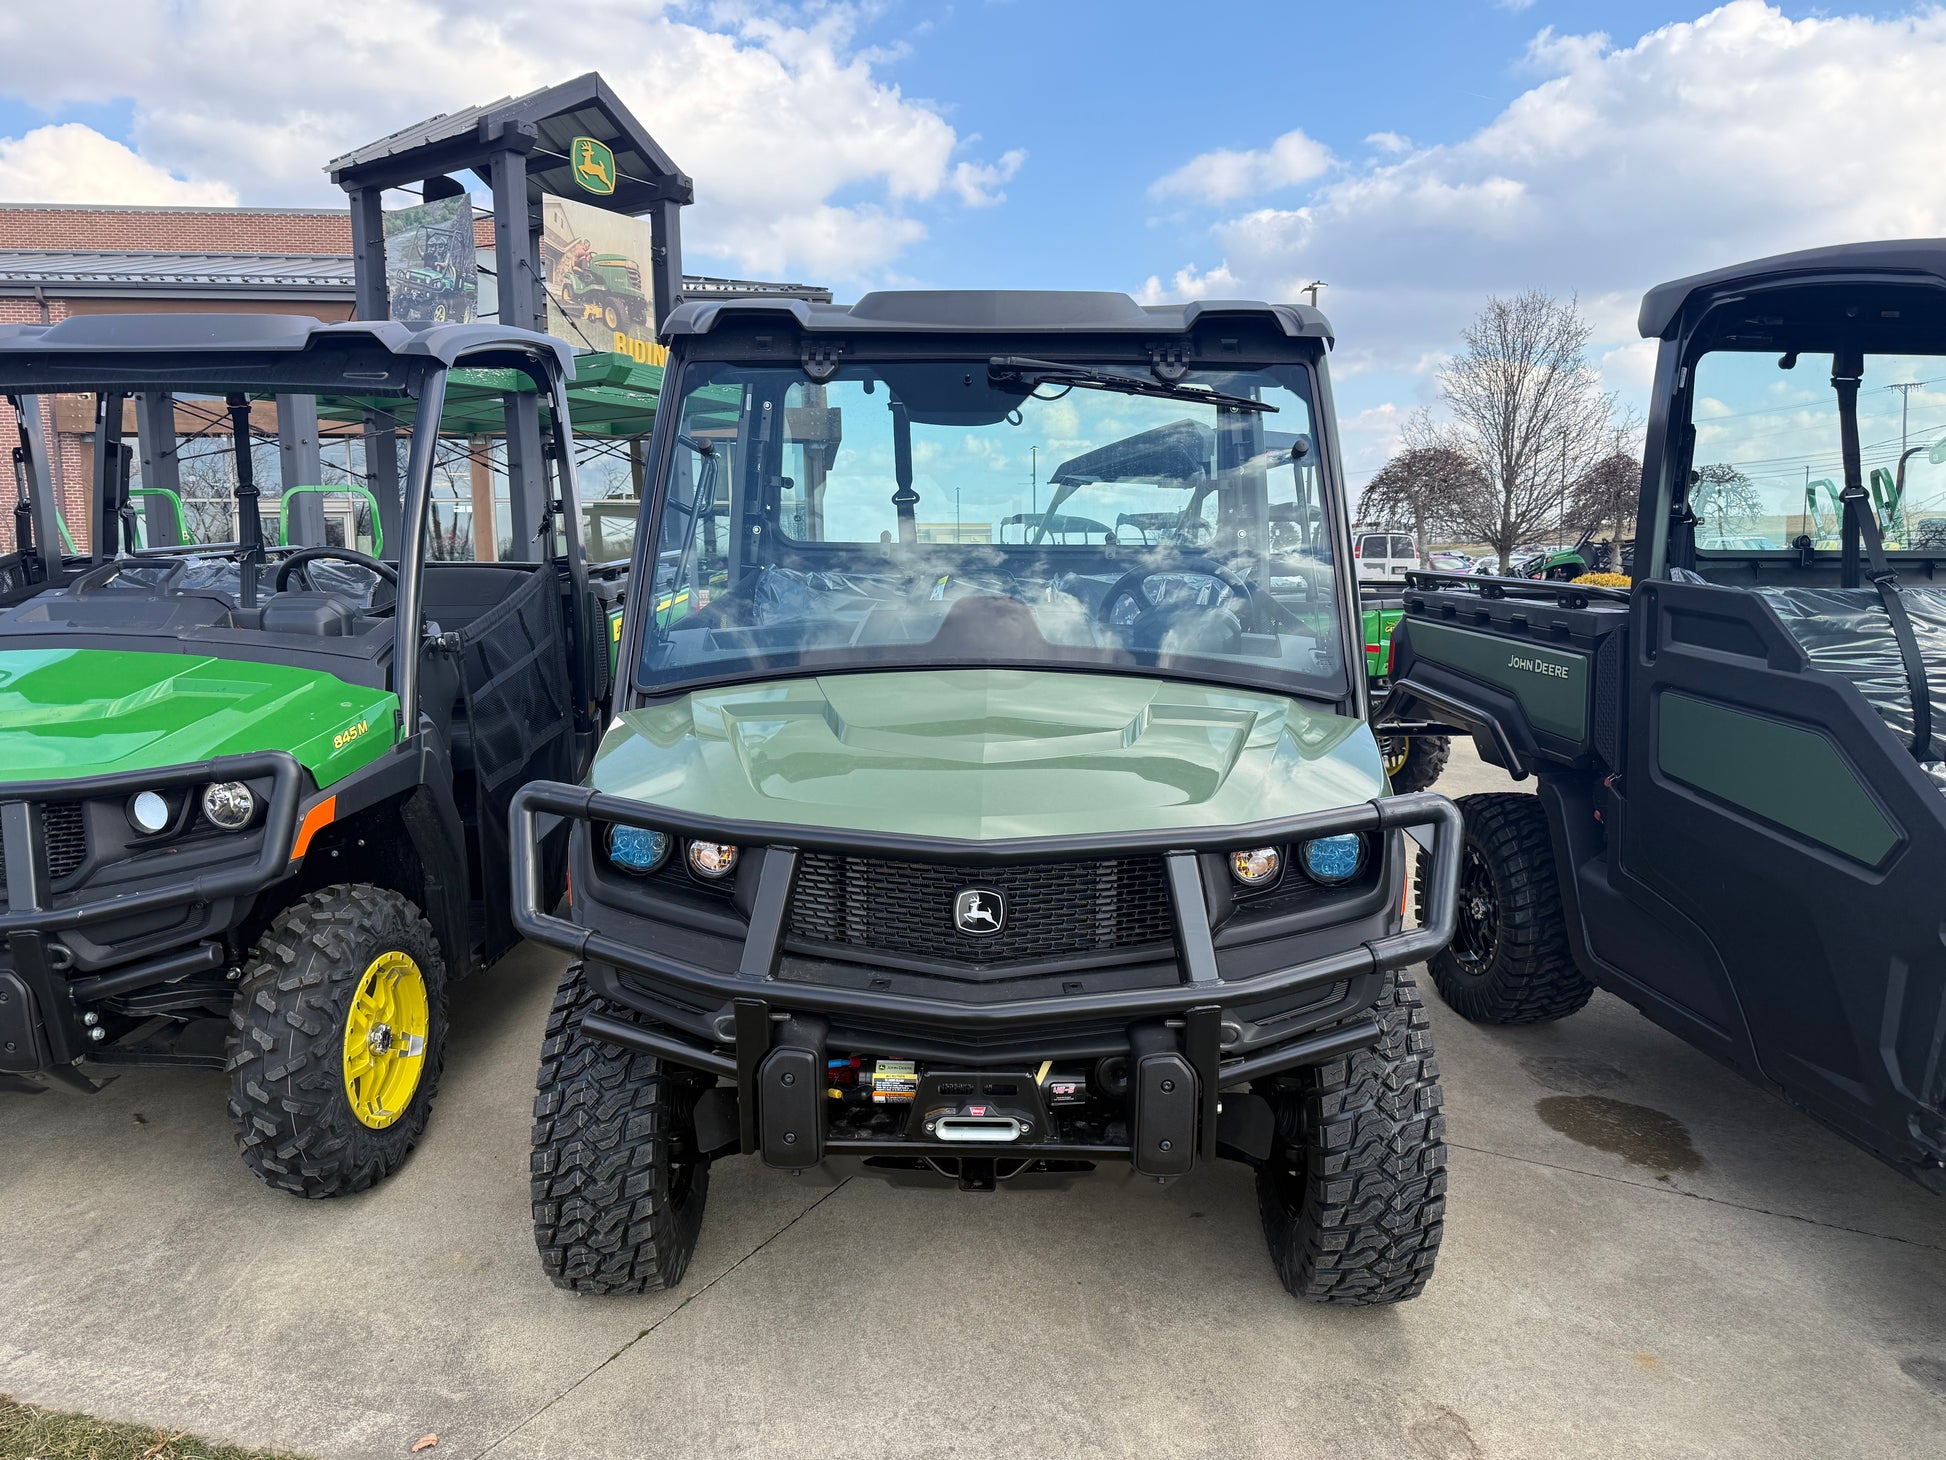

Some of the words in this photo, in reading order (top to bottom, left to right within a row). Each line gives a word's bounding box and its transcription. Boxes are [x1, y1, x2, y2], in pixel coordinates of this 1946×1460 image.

[613, 331, 670, 368] RIDIN
[1507, 654, 1533, 671] JOHN
[1534, 659, 1569, 679] DEERE
